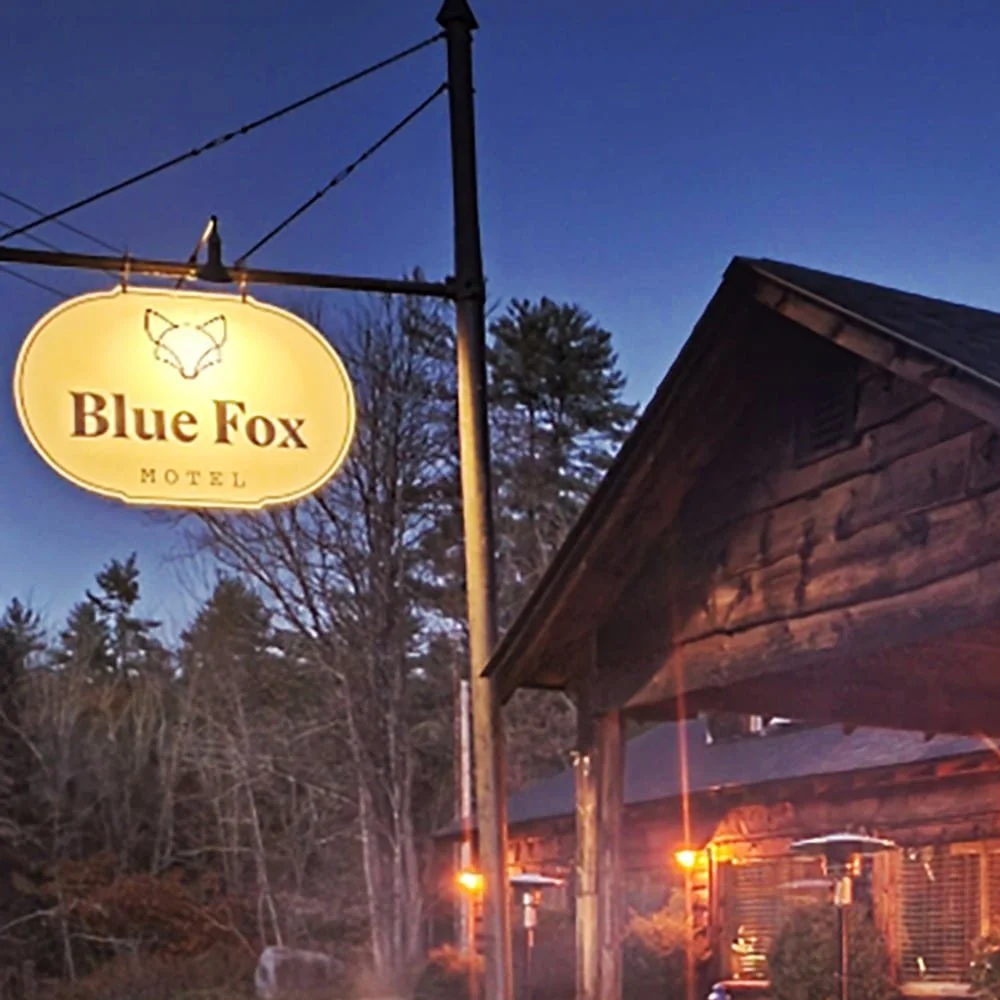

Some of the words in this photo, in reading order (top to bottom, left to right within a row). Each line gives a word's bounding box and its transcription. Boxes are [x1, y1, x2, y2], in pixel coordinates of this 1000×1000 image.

[69, 390, 198, 443] Blue
[213, 399, 308, 449] Fox
[140, 467, 247, 489] MOTEL
